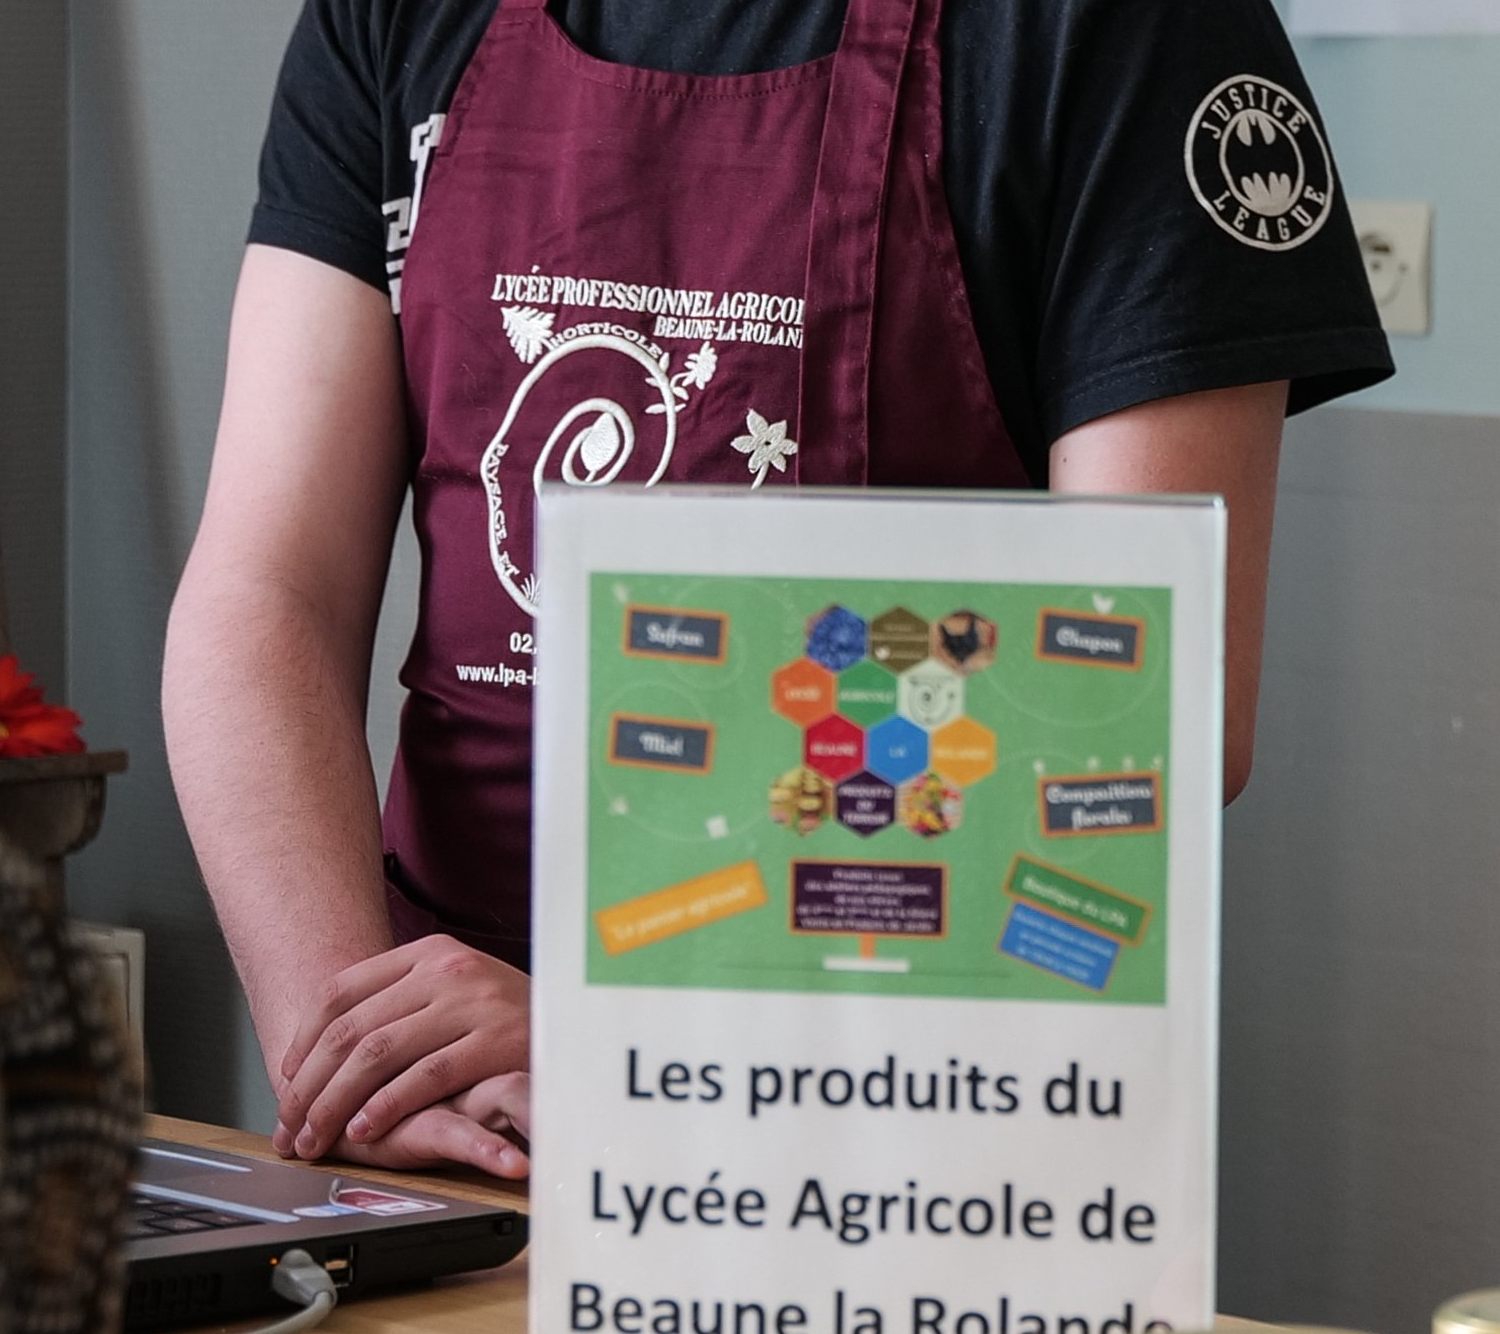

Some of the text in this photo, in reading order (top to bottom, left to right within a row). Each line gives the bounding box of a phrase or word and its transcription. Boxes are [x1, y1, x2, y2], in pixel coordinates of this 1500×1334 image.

[1201, 83, 1307, 141] JUSTICE
[1213, 185, 1326, 241] LEAGUE
[490, 264, 551, 303] LYCÉE
[551, 275, 714, 318] PROFESSIONNEL
[547, 322, 664, 360] HORTICOLE
[485, 442, 510, 546] PAYSAGE
[626, 1047, 1125, 1120] Les produits du
[591, 1169, 1158, 1245] Lycée Agricole de
